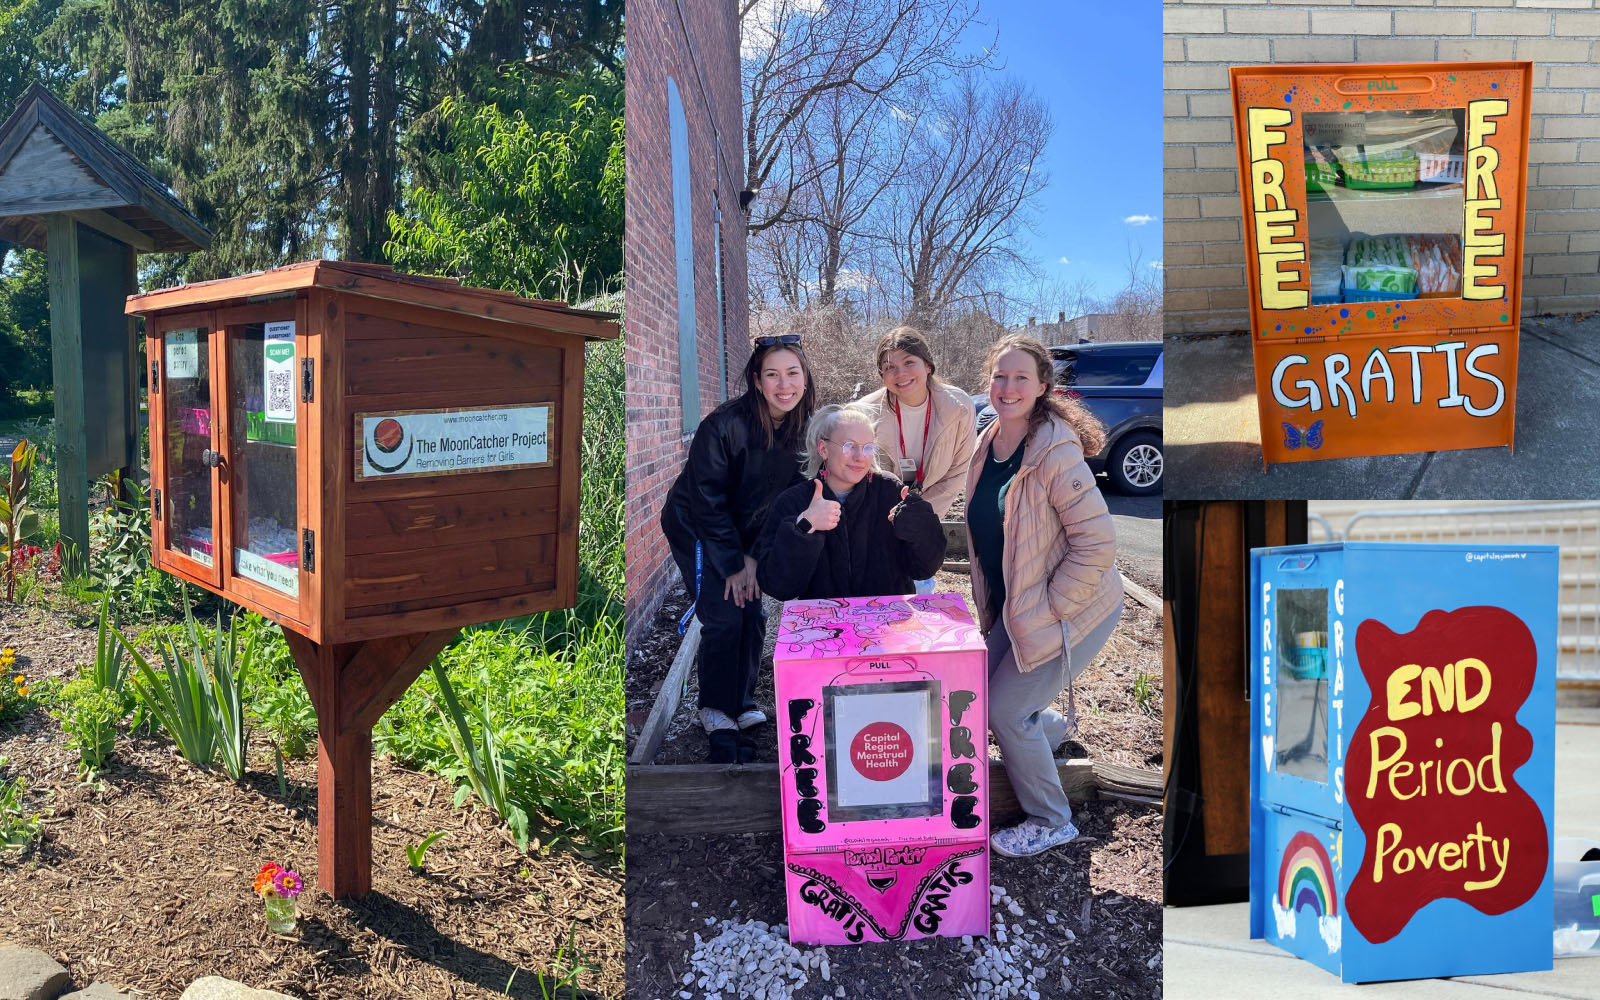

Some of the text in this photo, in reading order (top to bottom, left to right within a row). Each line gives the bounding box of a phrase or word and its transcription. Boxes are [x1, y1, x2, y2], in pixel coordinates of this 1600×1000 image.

[1368, 80, 1399, 91] PULL
[1248, 107, 1309, 310] FREE
[1462, 99, 1509, 300] FREE
[269, 348, 281, 356] SCAN
[1271, 341, 1506, 418] GRATIS
[416, 431, 546, 454] The MoonCatcher Project
[443, 413, 508, 424] www.mooncatcher.org
[416, 450, 514, 469] Removing Barriers for Girls
[869, 661, 892, 670] PULL
[1263, 581, 1272, 727] FREE
[1332, 579, 1345, 804] GRATIS
[1387, 658, 1492, 721] END
[788, 698, 827, 834] FREE
[857, 749, 907, 760] Menstrual
[863, 732, 900, 744] Capital
[864, 742, 900, 753] Region
[866, 758, 899, 768] Health
[947, 690, 981, 829] FREE
[1366, 722, 1507, 800] Period
[844, 846, 927, 866] Period Pantry
[1373, 821, 1509, 891] Poverty
[800, 880, 866, 942] GRATIS
[913, 862, 973, 934] GRATIS
